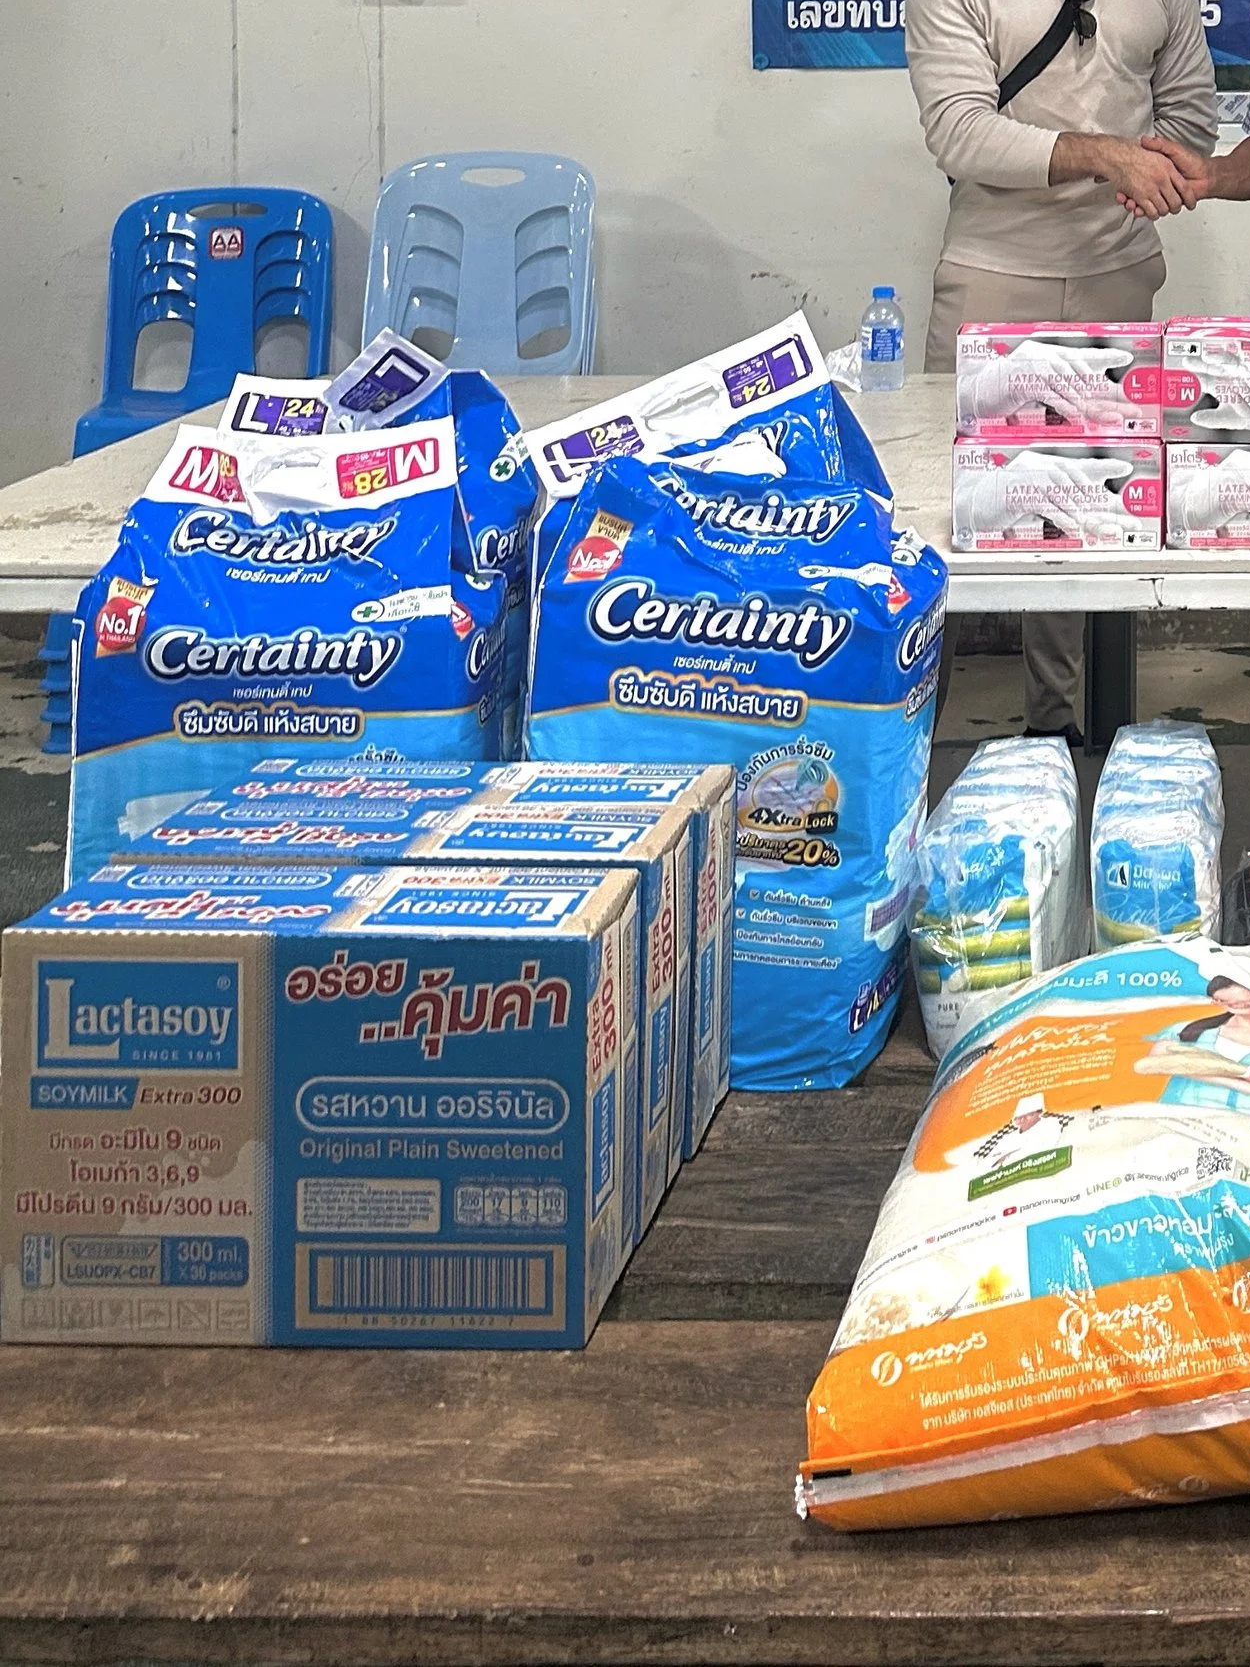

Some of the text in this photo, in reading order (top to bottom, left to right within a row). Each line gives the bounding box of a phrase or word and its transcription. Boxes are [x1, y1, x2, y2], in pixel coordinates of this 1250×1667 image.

[742, 341, 806, 402] L 24
[1008, 374, 1039, 383] LATEX
[1073, 383, 1109, 392] GLOVES
[1180, 388, 1194, 400] M
[1215, 386, 1250, 395] GLOVES
[283, 400, 314, 417] 24
[354, 441, 435, 494] M 28
[1006, 485, 1039, 494] LATEX
[1073, 494, 1108, 503] GLOVES
[1128, 486, 1143, 499] M
[1219, 484, 1250, 493] LATEX
[175, 509, 396, 570] Certainty
[99, 605, 144, 635] No.1
[592, 581, 852, 662] Certainty
[148, 631, 399, 684] Certainty
[618, 678, 799, 718] ซึมซับดี แห้งสบาย
[183, 708, 356, 737] ซึมซับดี แห้งสบาย
[805, 814, 834, 829] Lock
[784, 839, 837, 865] 20%
[286, 950, 407, 1001] อร่อย
[1117, 970, 1182, 987] 100%
[44, 978, 233, 1059] Lactasoy
[602, 978, 617, 1056] 300
[590, 998, 602, 1073] Extra
[132, 1050, 222, 1062] SINCE 1981
[38, 1085, 242, 1105] SOYMILK Extra 300
[311, 1089, 553, 1120] รสหวาน ออริจินัล
[100, 1128, 160, 1150] อะมิโน
[166, 1129, 182, 1150] 9
[300, 1139, 563, 1163] Original Plain Sweetened
[593, 1084, 615, 1208] Lactasoy
[70, 1159, 200, 1186] โอเมก้า 3,6,9
[16, 1191, 253, 1216] มีโปรตีน 9 กรัม/300 มล.
[177, 1241, 213, 1263] 300
[218, 1246, 242, 1263] ml.
